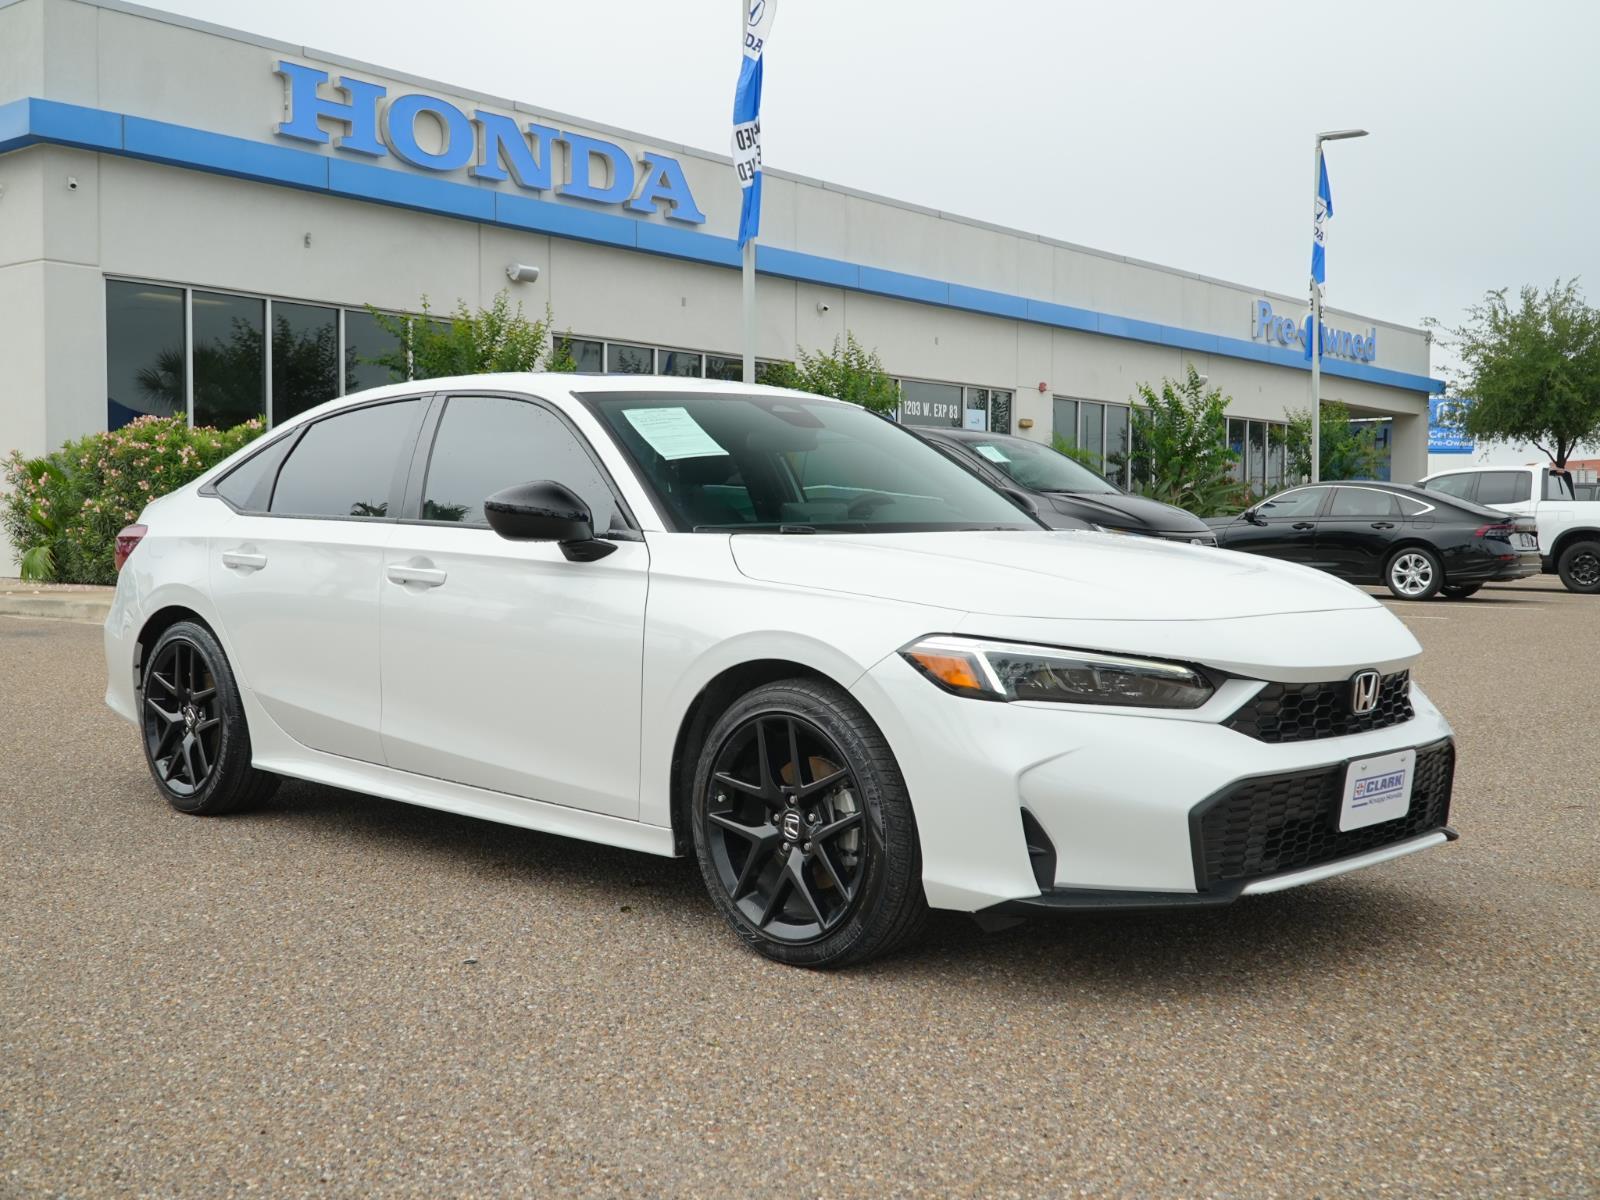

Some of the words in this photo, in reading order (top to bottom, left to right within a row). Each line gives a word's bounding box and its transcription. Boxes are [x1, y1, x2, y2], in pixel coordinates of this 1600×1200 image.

[273, 60, 706, 225] HONDA
[1253, 299, 1377, 362] Pre-wned
[904, 401, 921, 416] 1203
[923, 402, 932, 417] W.
[934, 403, 947, 419] EXP
[949, 404, 958, 419] 83
[1366, 774, 1403, 793] CLARK
